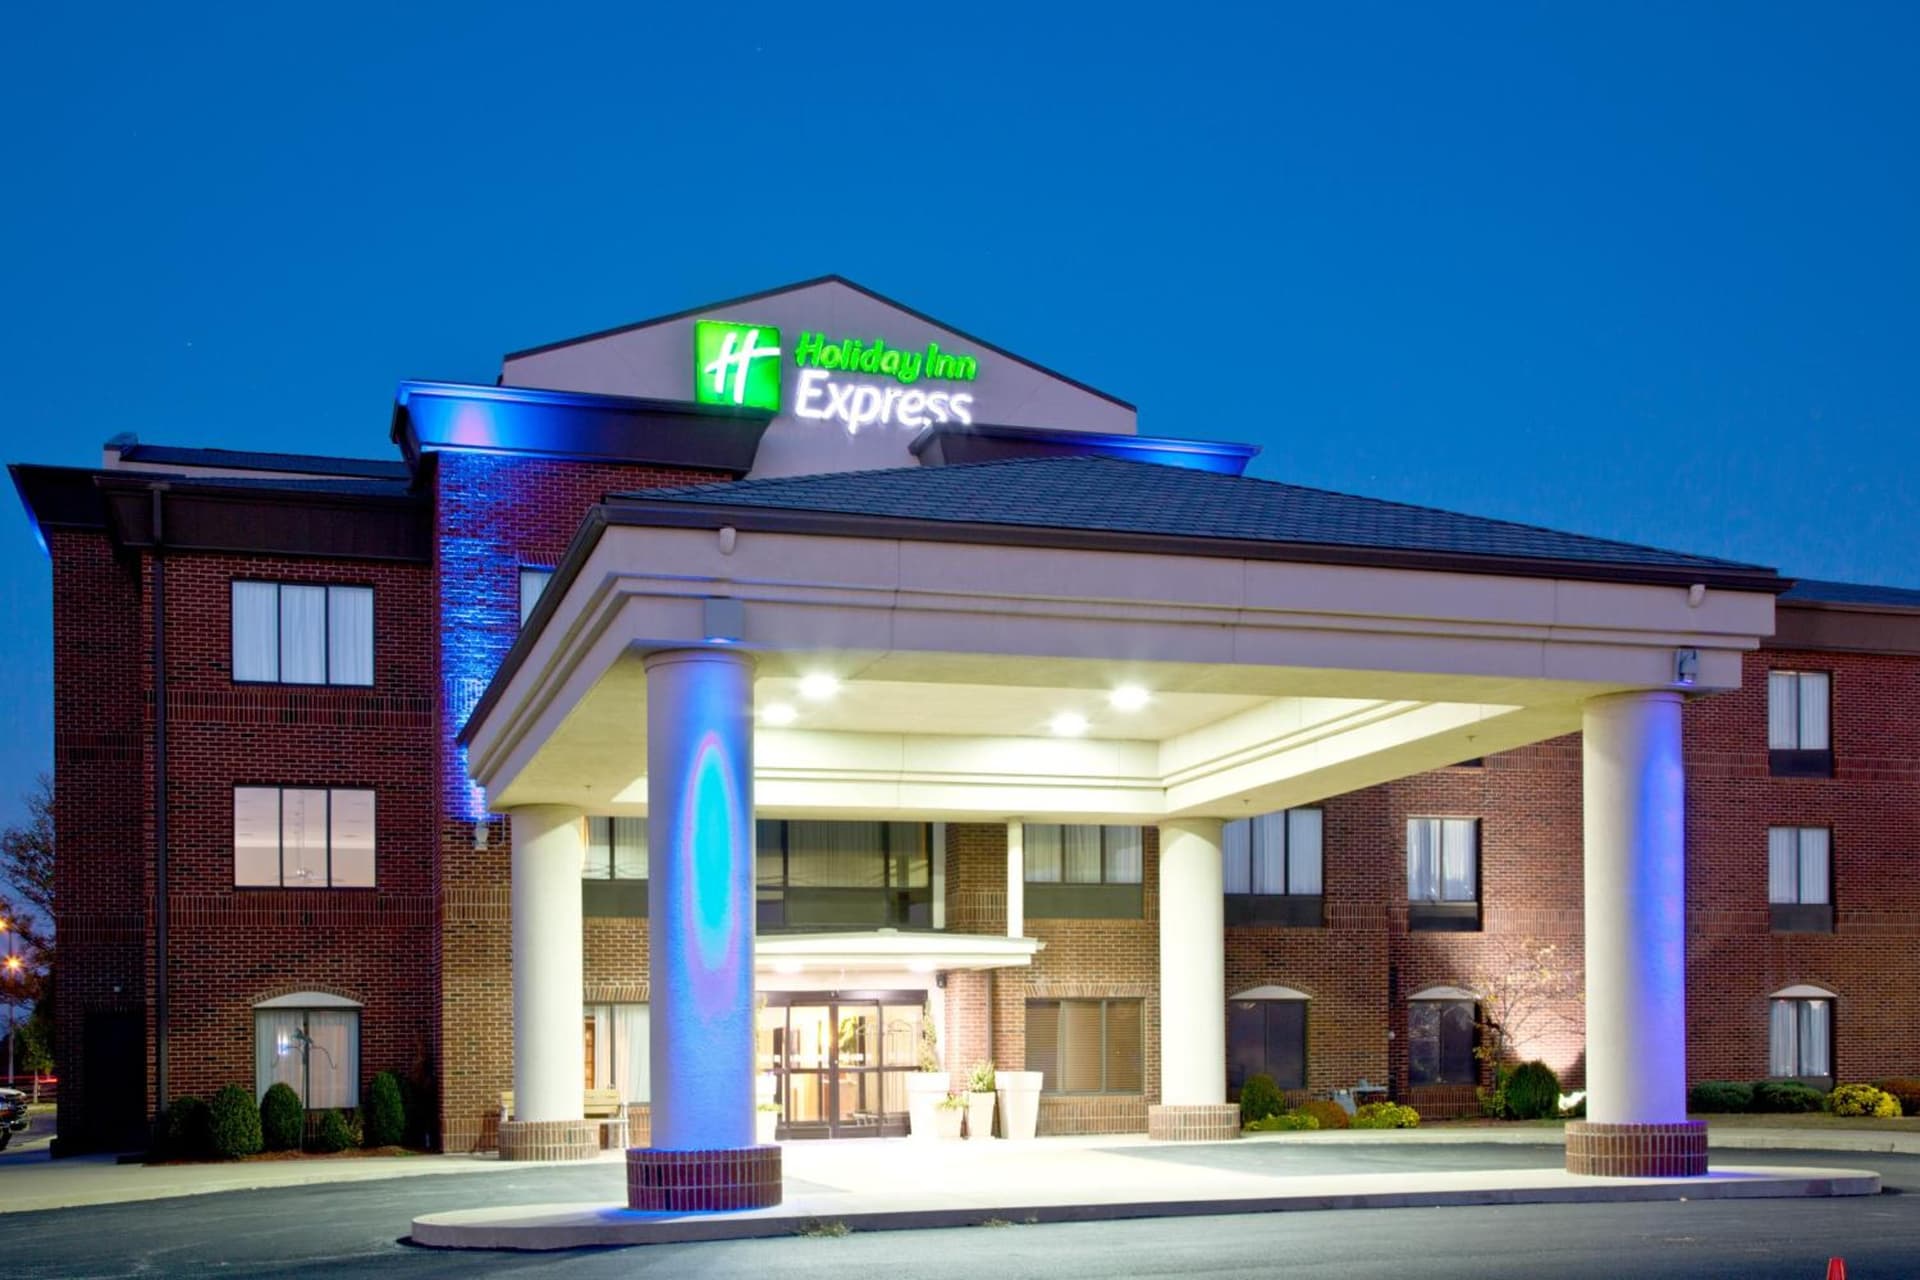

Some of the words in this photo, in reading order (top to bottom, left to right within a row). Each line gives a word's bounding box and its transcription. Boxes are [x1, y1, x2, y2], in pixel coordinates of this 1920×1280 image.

[795, 331, 921, 383] Holiday
[925, 343, 977, 380] Inn
[795, 369, 974, 434] Express
